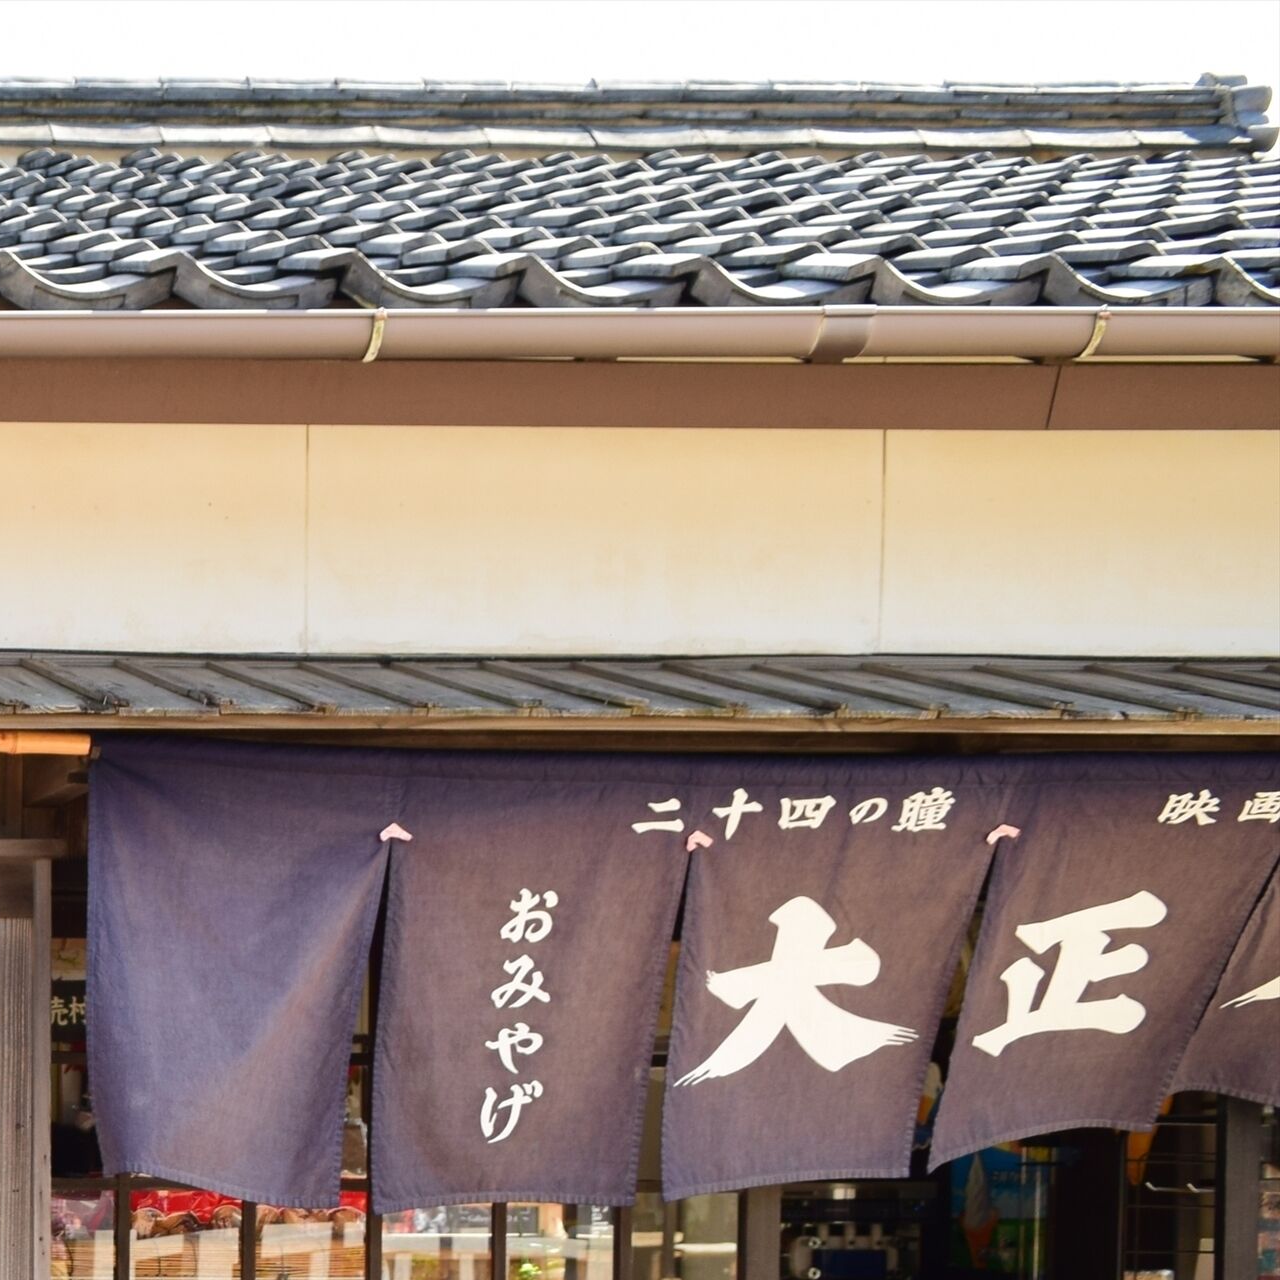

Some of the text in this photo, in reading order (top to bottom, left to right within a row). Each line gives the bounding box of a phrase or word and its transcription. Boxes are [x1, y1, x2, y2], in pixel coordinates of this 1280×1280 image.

[631, 787, 955, 840] 二十四の瞳
[480, 888, 558, 1144] おみやげ
[673, 890, 1280, 1088] 大正
